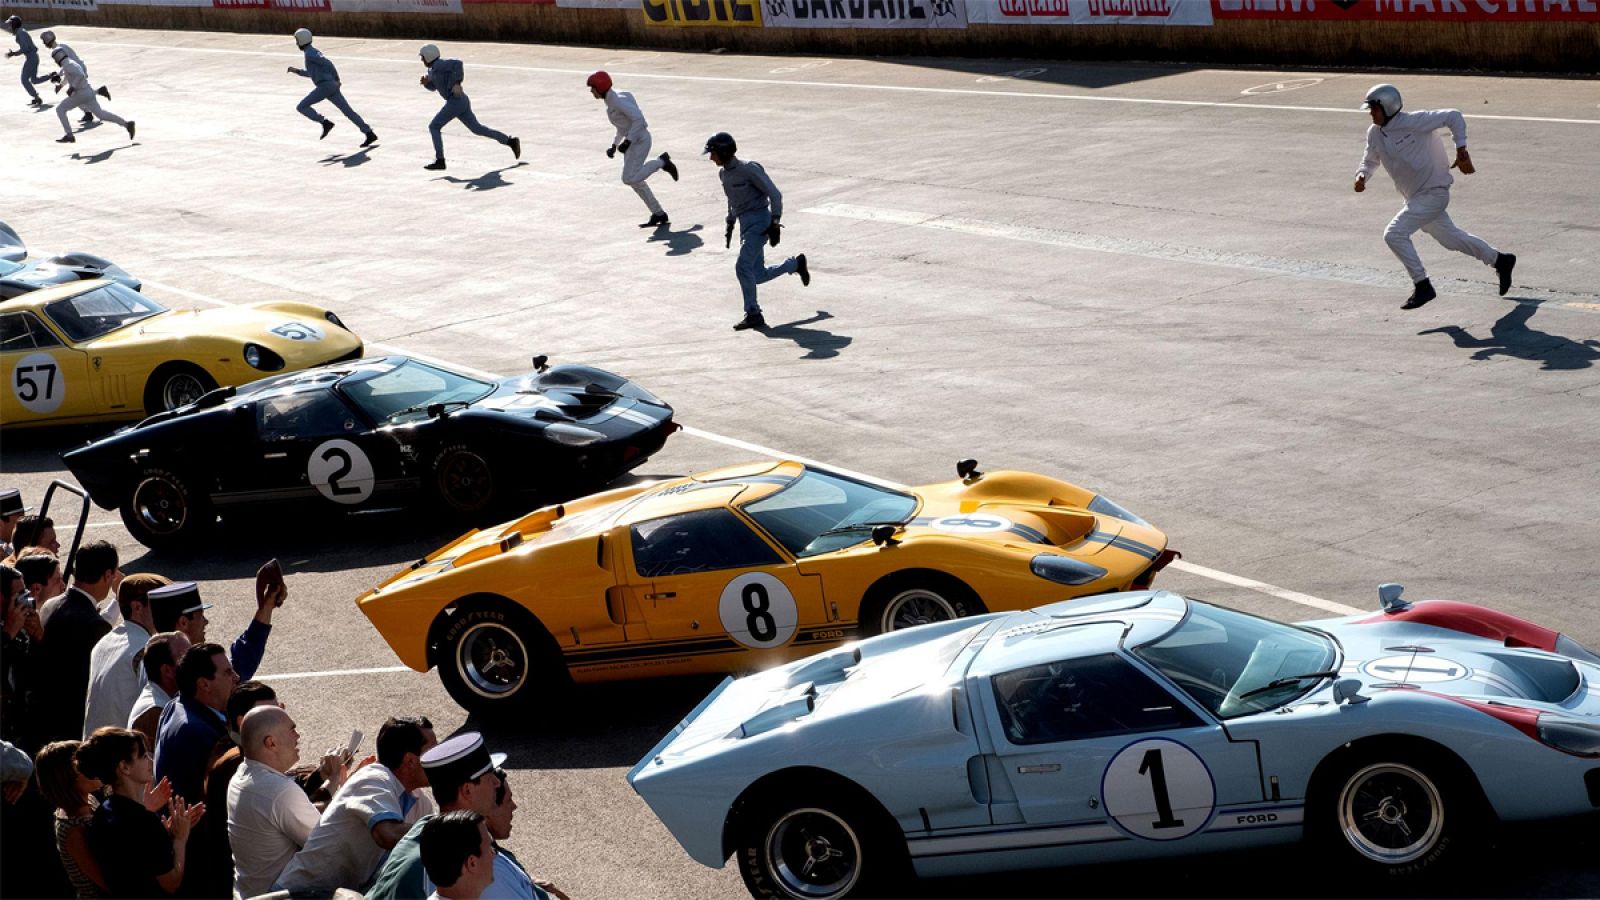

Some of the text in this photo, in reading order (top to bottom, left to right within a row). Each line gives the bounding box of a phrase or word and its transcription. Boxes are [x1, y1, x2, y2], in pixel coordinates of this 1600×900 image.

[16, 364, 56, 402] 57
[321, 447, 361, 496] 2
[940, 519, 1002, 529] 8
[741, 583, 777, 641] 8
[813, 630, 844, 640] FORD
[1375, 665, 1457, 676] 1
[1138, 749, 1184, 829] 1
[1237, 813, 1278, 824] FORD
